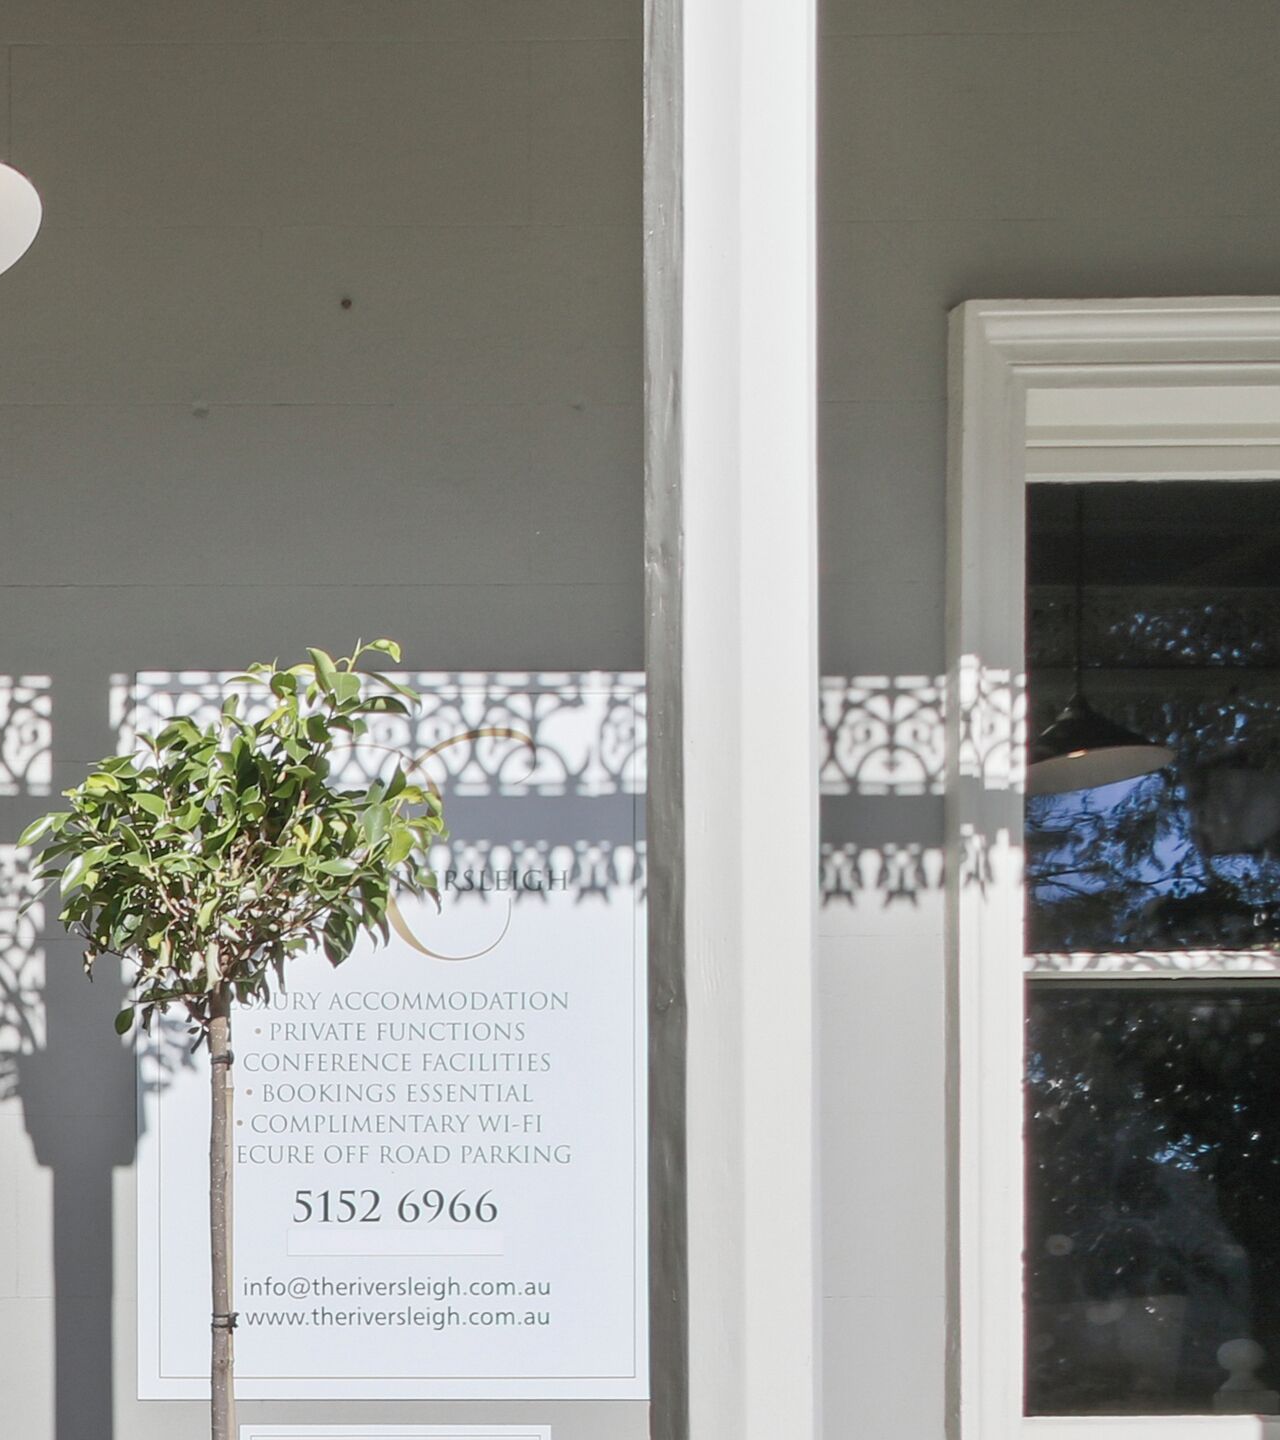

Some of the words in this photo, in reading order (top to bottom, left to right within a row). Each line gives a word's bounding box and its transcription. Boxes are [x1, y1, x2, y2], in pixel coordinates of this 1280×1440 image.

[328, 992, 569, 1010] ACCOMMODATION
[270, 1022, 367, 1041] PRIVATE
[376, 1022, 526, 1041] FUNCTIONS
[243, 1053, 412, 1072] CONFERENCE
[422, 1053, 551, 1072] FACILITIES
[262, 1083, 396, 1102] BOOKINGS
[406, 1083, 534, 1102] ESSENTIAL
[251, 1114, 469, 1133] COMPLIMENTARY
[477, 1114, 542, 1133] WI-FI
[237, 1145, 315, 1164] ECURE
[323, 1145, 370, 1164] OFF
[379, 1145, 450, 1164] ROAD
[460, 1145, 572, 1164] PARKING
[292, 1189, 382, 1223] 5152
[397, 1188, 499, 1223] 6966
[243, 1276, 551, 1300] info@theriversleigh.com.au
[245, 1306, 550, 1330] www.theriversleigh.com.au
